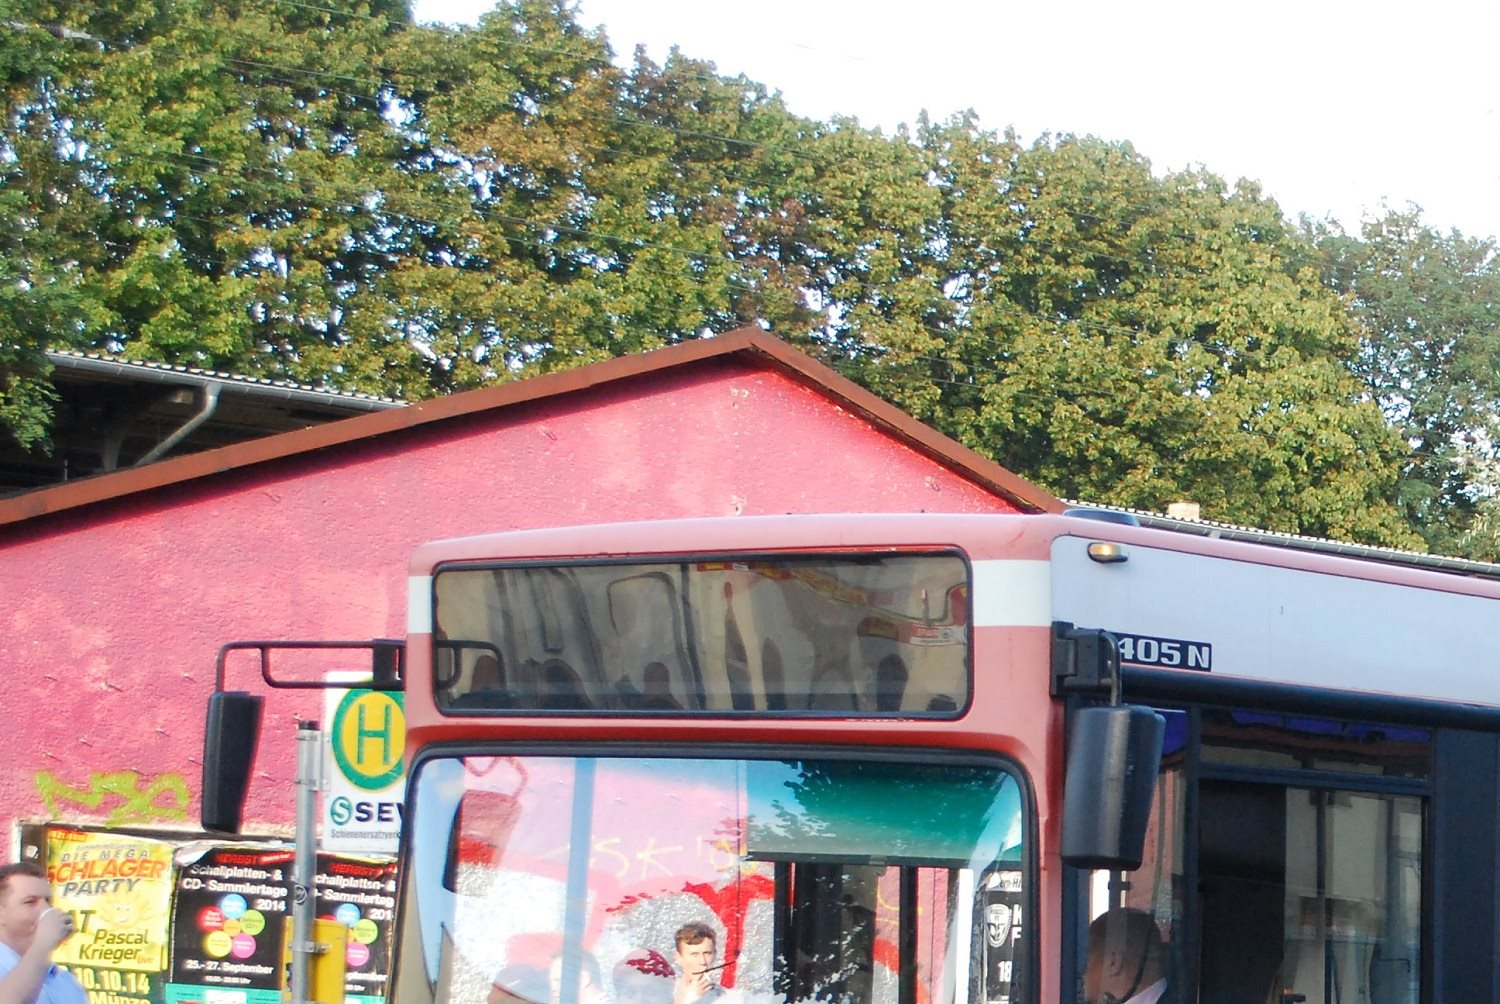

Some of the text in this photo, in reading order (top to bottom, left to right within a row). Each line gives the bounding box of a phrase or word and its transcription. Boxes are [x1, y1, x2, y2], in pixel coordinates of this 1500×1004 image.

[1118, 637, 1209, 668] 405 N
[357, 704, 391, 765] H
[331, 829, 401, 839] Schienenersatzverk
[62, 849, 150, 862] DIE MEGA
[47, 858, 168, 884] SCHLAGER
[63, 878, 141, 897] PARTY
[315, 874, 384, 890] challplatten-
[257, 899, 286, 911] 2014
[325, 889, 395, 908] Sammlertag
[370, 909, 393, 920] 201
[93, 928, 149, 945] Pascal
[79, 944, 142, 965] Krieger
[223, 962, 274, 975] September
[346, 972, 388, 982] ptember
